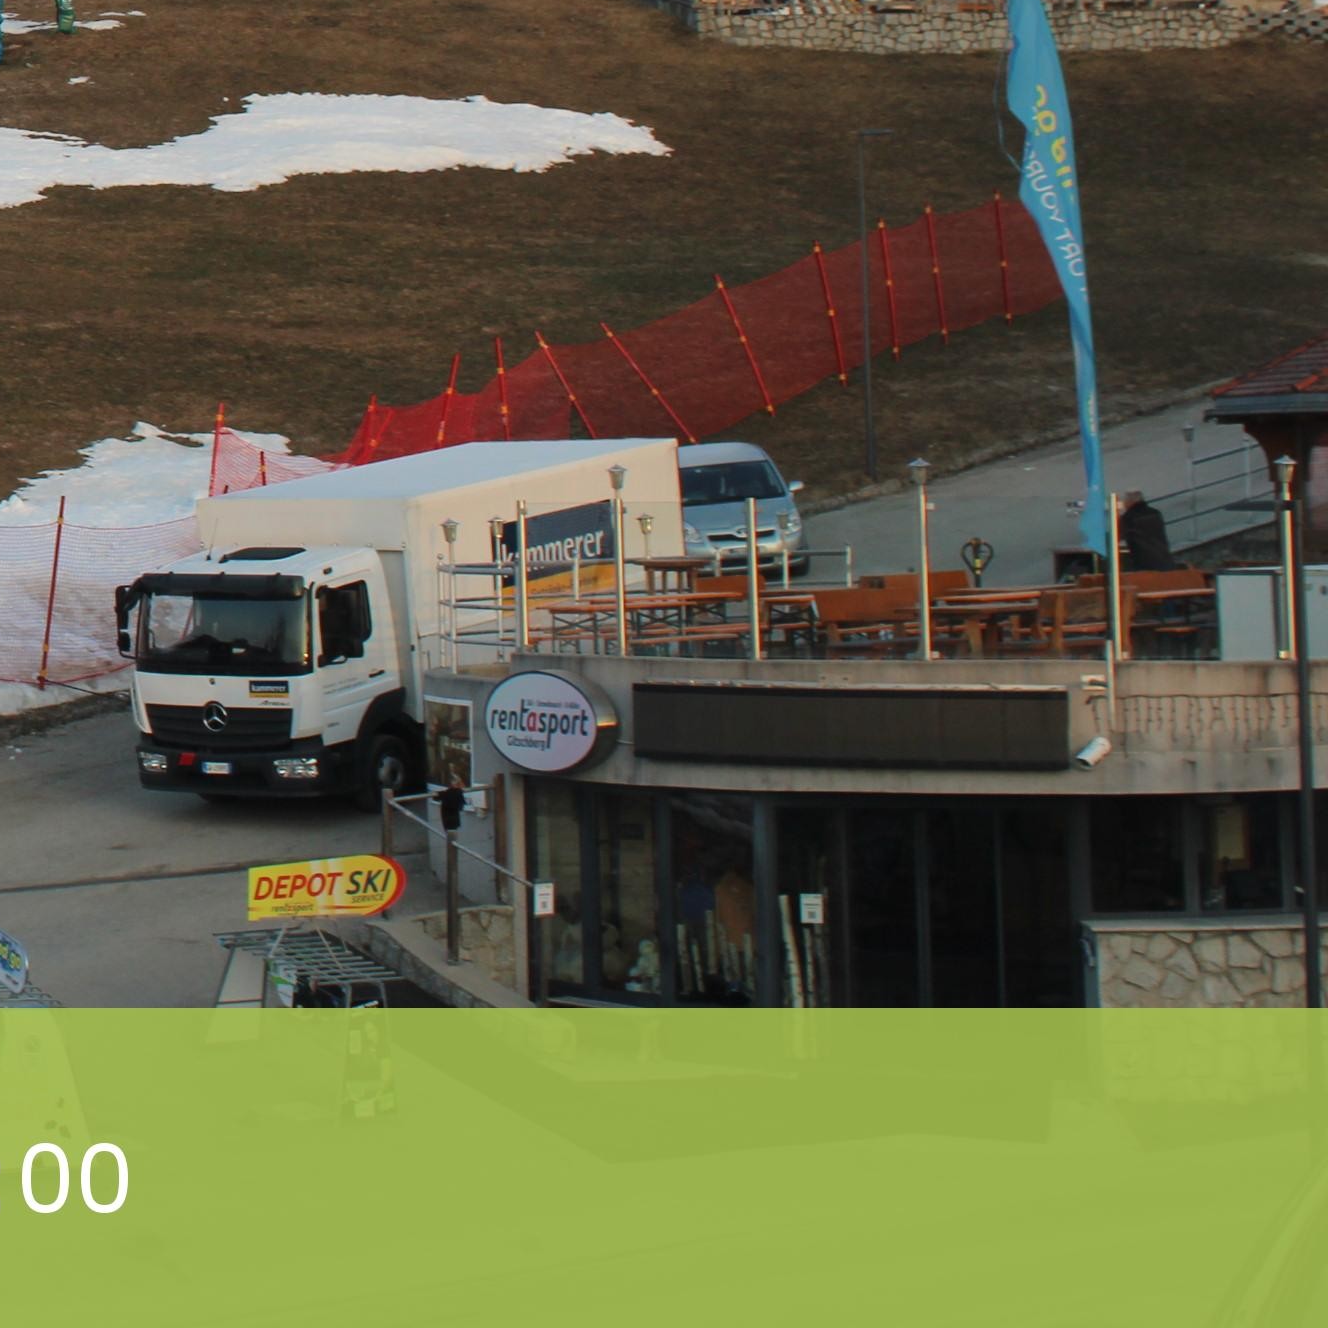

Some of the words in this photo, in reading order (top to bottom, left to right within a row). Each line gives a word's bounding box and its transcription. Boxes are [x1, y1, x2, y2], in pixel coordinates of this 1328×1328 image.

[501, 529, 604, 579] kmmerer
[490, 698, 589, 749] rentasport
[254, 872, 343, 901] DEPOT
[345, 868, 392, 895] SKI
